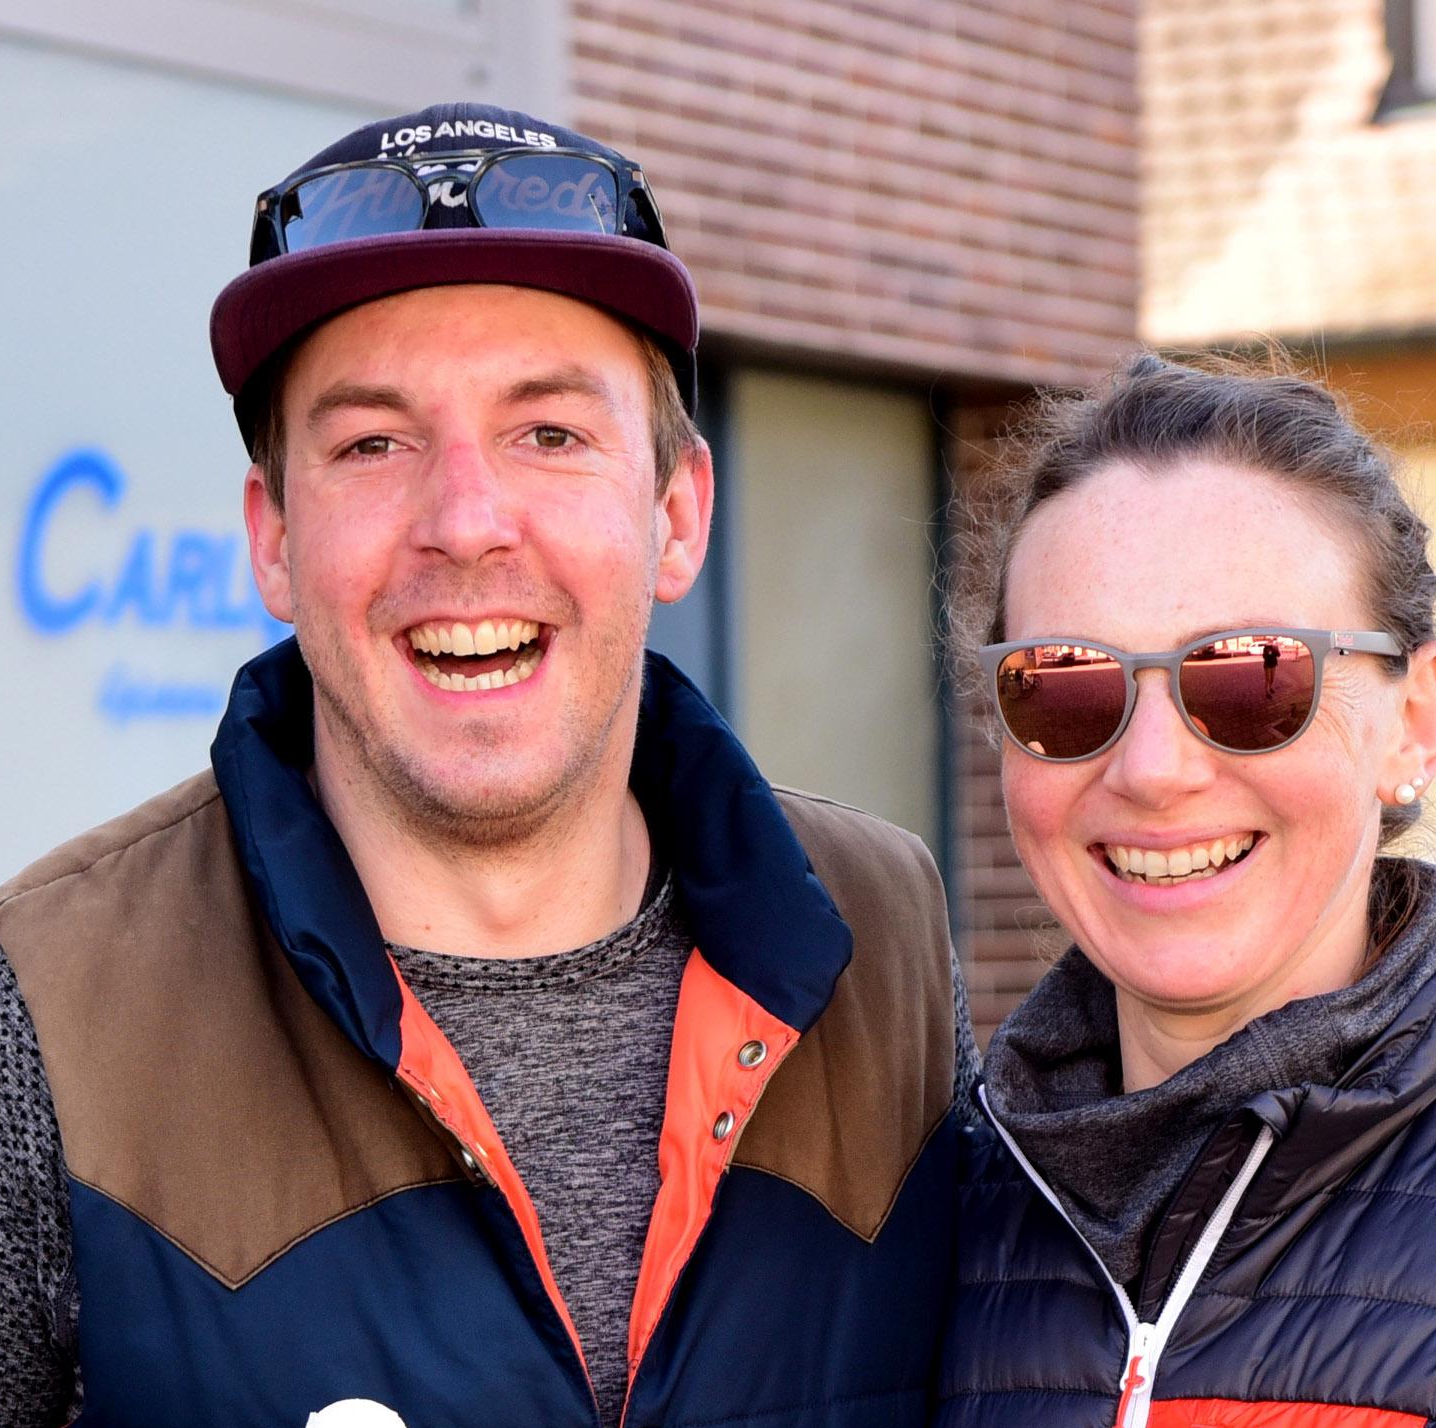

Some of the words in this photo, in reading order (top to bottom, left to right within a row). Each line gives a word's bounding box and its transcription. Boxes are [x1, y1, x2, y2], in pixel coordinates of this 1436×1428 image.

[381, 125, 432, 151] LOS
[434, 120, 557, 149] ANGELES
[19, 447, 275, 638] CARL
